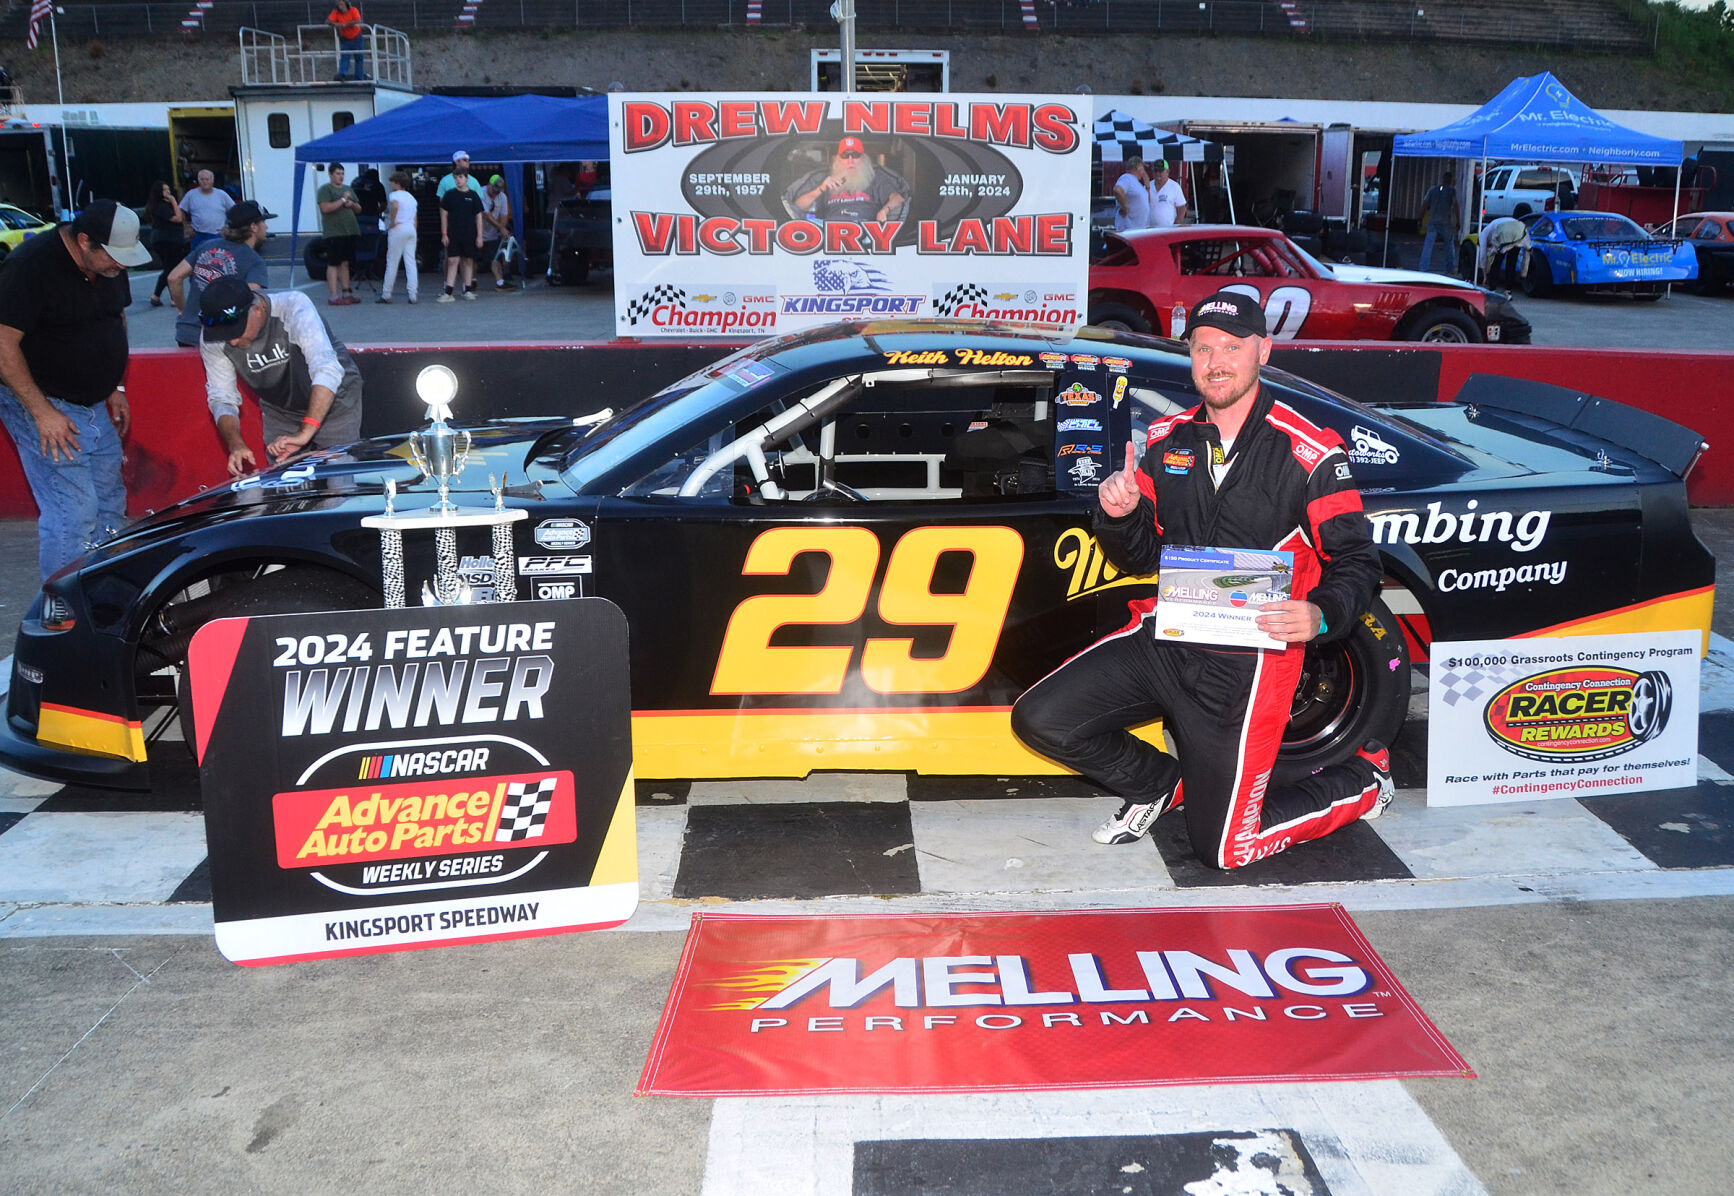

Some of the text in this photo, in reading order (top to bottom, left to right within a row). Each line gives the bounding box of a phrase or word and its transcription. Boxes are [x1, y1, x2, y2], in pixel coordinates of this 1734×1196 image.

[622, 100, 1080, 155] DREW NELMS
[1519, 112, 1547, 122] Mr.
[1510, 143, 1660, 158] MrElectric.com Neighborly.com
[689, 173, 771, 185] SEPTEMBER
[944, 174, 1006, 186] JANUARY
[695, 185, 765, 197] 29th, 1957
[939, 185, 1010, 198] 25th, 2024
[630, 210, 1073, 257] VICTORY LANE
[1631, 252, 1673, 264] Electric
[783, 296, 925, 314] KINGSPORT
[1044, 293, 1075, 301] GMC
[1199, 302, 1238, 313] MELLING
[651, 305, 776, 333] Champion
[953, 303, 1077, 324] Champion
[246, 343, 290, 369] Huk
[883, 348, 1034, 366] Keith Helton
[1062, 392, 1096, 402] TEXAS
[1150, 426, 1170, 438] OMP
[1296, 445, 1318, 460] OMP
[1348, 449, 1386, 458] utoworks
[1370, 500, 1552, 552] mbing
[460, 556, 495, 569] Holle
[525, 556, 589, 568] PFC
[1437, 560, 1568, 593] Company
[538, 586, 575, 599] OMP
[1166, 585, 1218, 601] MELLING
[710, 525, 1025, 695] 29
[1193, 610, 1216, 618] 2024
[273, 621, 556, 668] 2024 FEATURE
[1448, 646, 1693, 669] $100,000 Grassroots Contingency Program
[1525, 676, 1632, 693] Contingency Connection
[281, 655, 555, 738] WINNER
[1506, 688, 1634, 721] RACER
[1520, 721, 1627, 743] REWARDS
[390, 747, 490, 779] NASCAR
[1445, 758, 1691, 785] Race with Parts that pay for themselves!
[1492, 775, 1644, 796] #ContingencyConnection
[315, 788, 490, 831] Advance
[1233, 768, 1272, 862] HAMPION
[296, 819, 485, 860] Auto Parts
[362, 855, 504, 886] WEEKLY SERIES
[325, 902, 541, 942] KINGSPORT SPEEDWAY
[756, 946, 1375, 1010] MELLING
[749, 1001, 1388, 1034] PERFORMANCE
